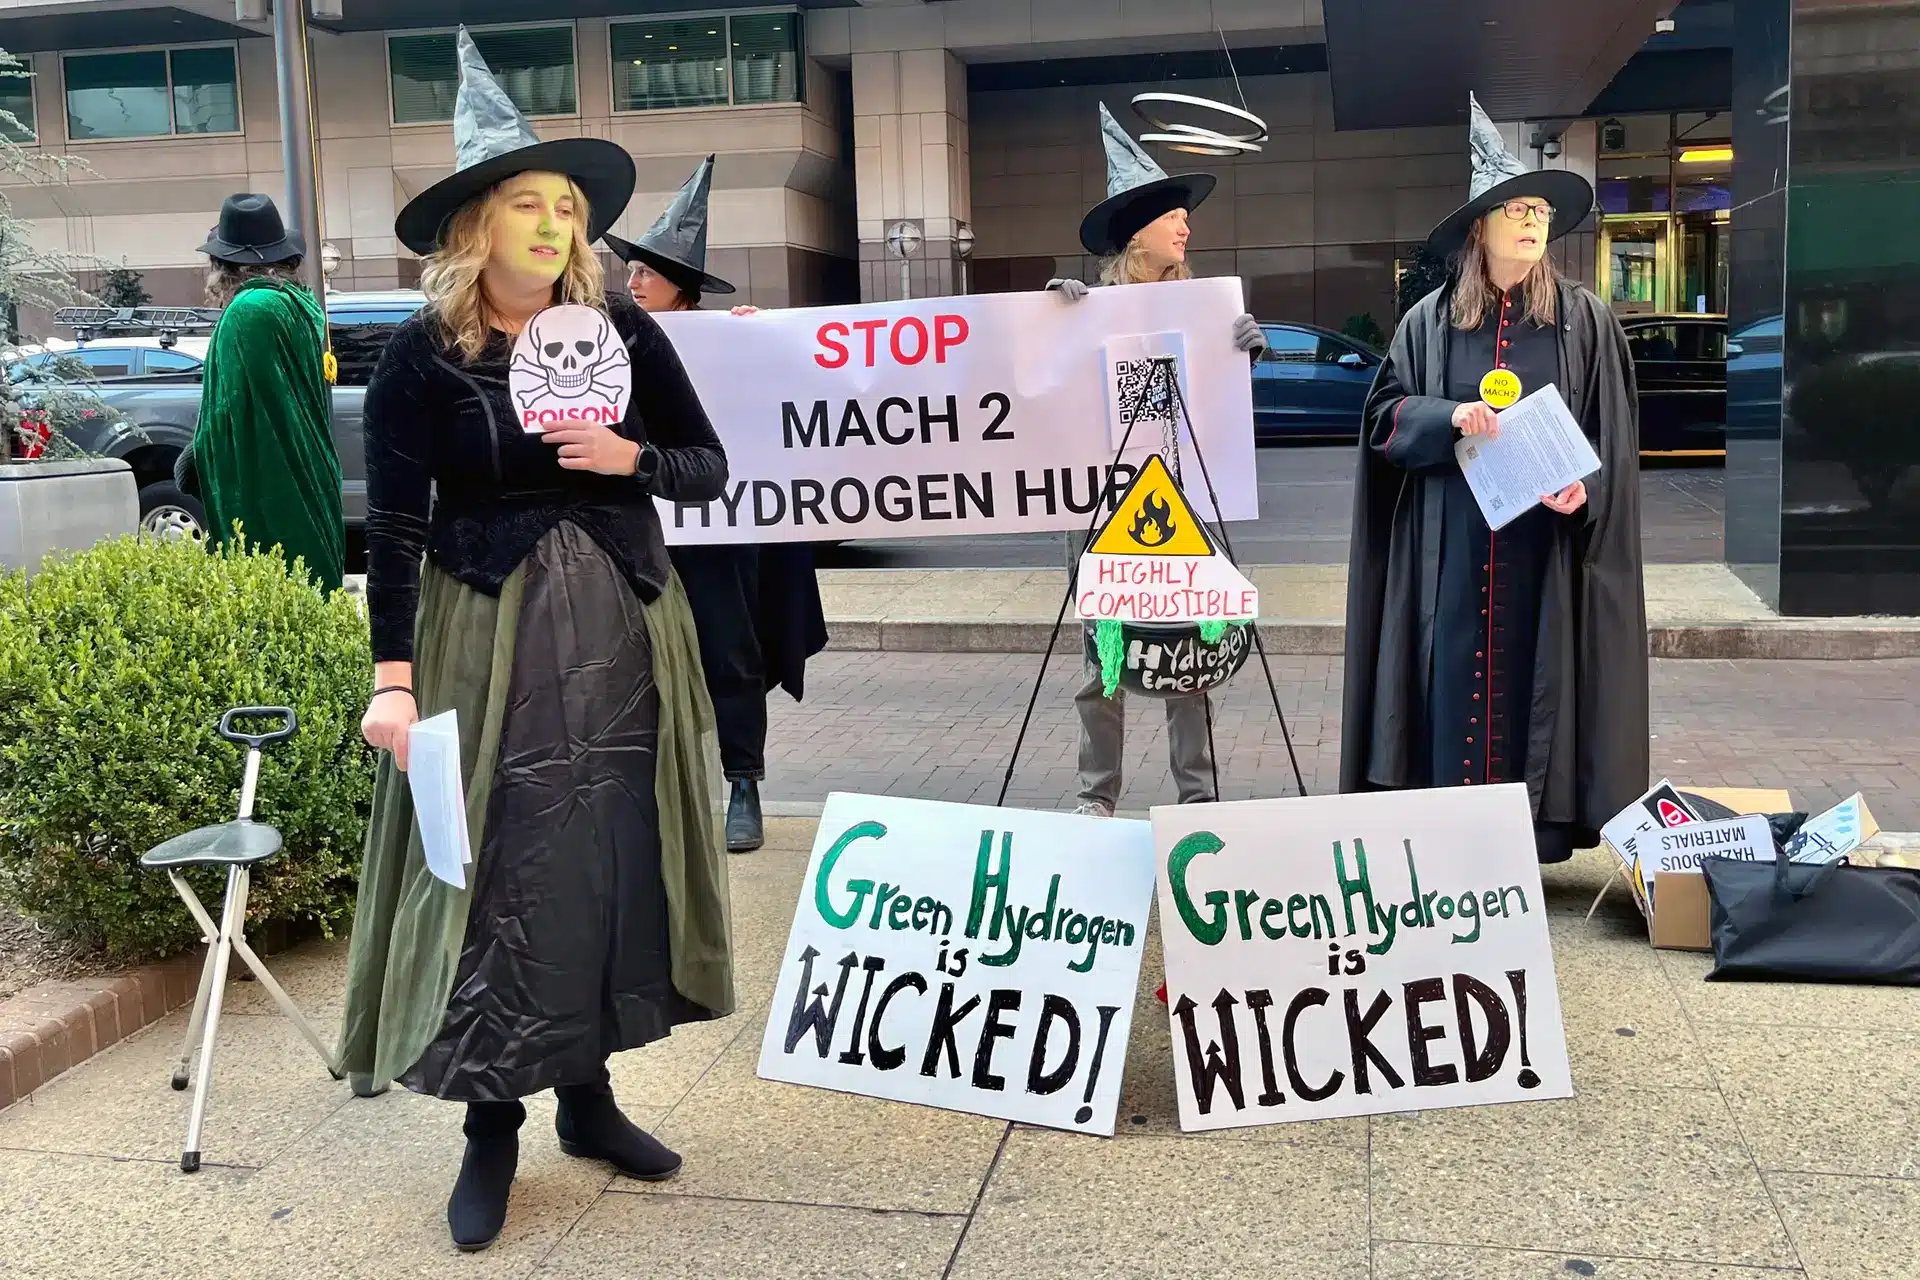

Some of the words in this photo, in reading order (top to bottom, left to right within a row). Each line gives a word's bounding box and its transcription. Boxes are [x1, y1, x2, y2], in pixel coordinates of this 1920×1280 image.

[813, 315, 970, 369] STOP
[1493, 378, 1508, 386] NO
[523, 405, 619, 428] POISON
[781, 395, 960, 449] MACH
[980, 392, 1015, 441] 2
[673, 469, 994, 529] HYDROGEN
[1099, 559, 1199, 587] HIGHLY
[1078, 589, 1257, 619] COMBUSTIBLE
[1141, 659, 1237, 692] Energy
[1661, 826, 1746, 850] MATERIALS
[814, 820, 954, 935] Green
[964, 829, 1135, 973] Hydrogen
[1166, 830, 1335, 946] Green
[1332, 837, 1530, 955] Hydrogen
[935, 939, 970, 978] is
[1328, 942, 1367, 976] is
[783, 944, 1123, 1124] WICKED!
[1172, 968, 1542, 1115] WICKED!
